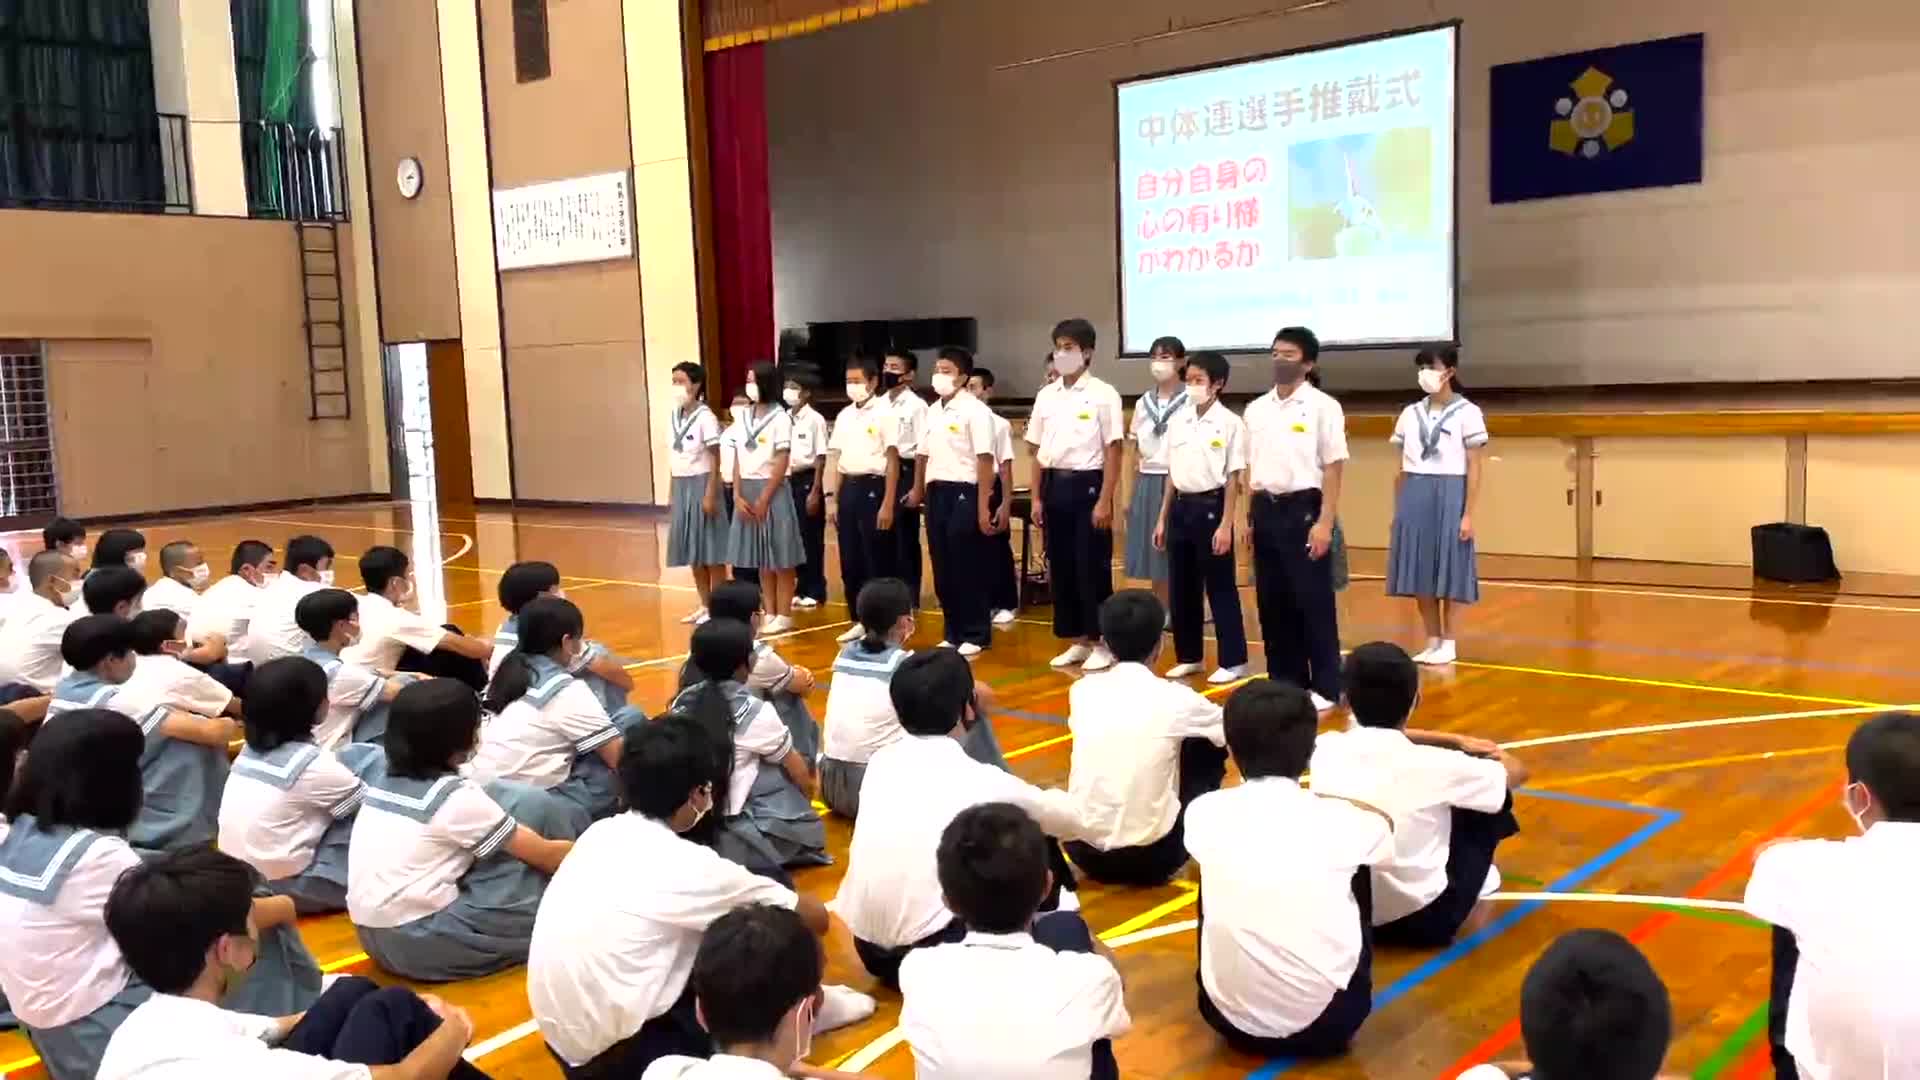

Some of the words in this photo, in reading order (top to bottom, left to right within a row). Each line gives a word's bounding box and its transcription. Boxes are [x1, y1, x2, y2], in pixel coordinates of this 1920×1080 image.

[1138, 70, 1422, 146] 中体連選手推戴式
[1137, 157, 1266, 201] 自分自身の
